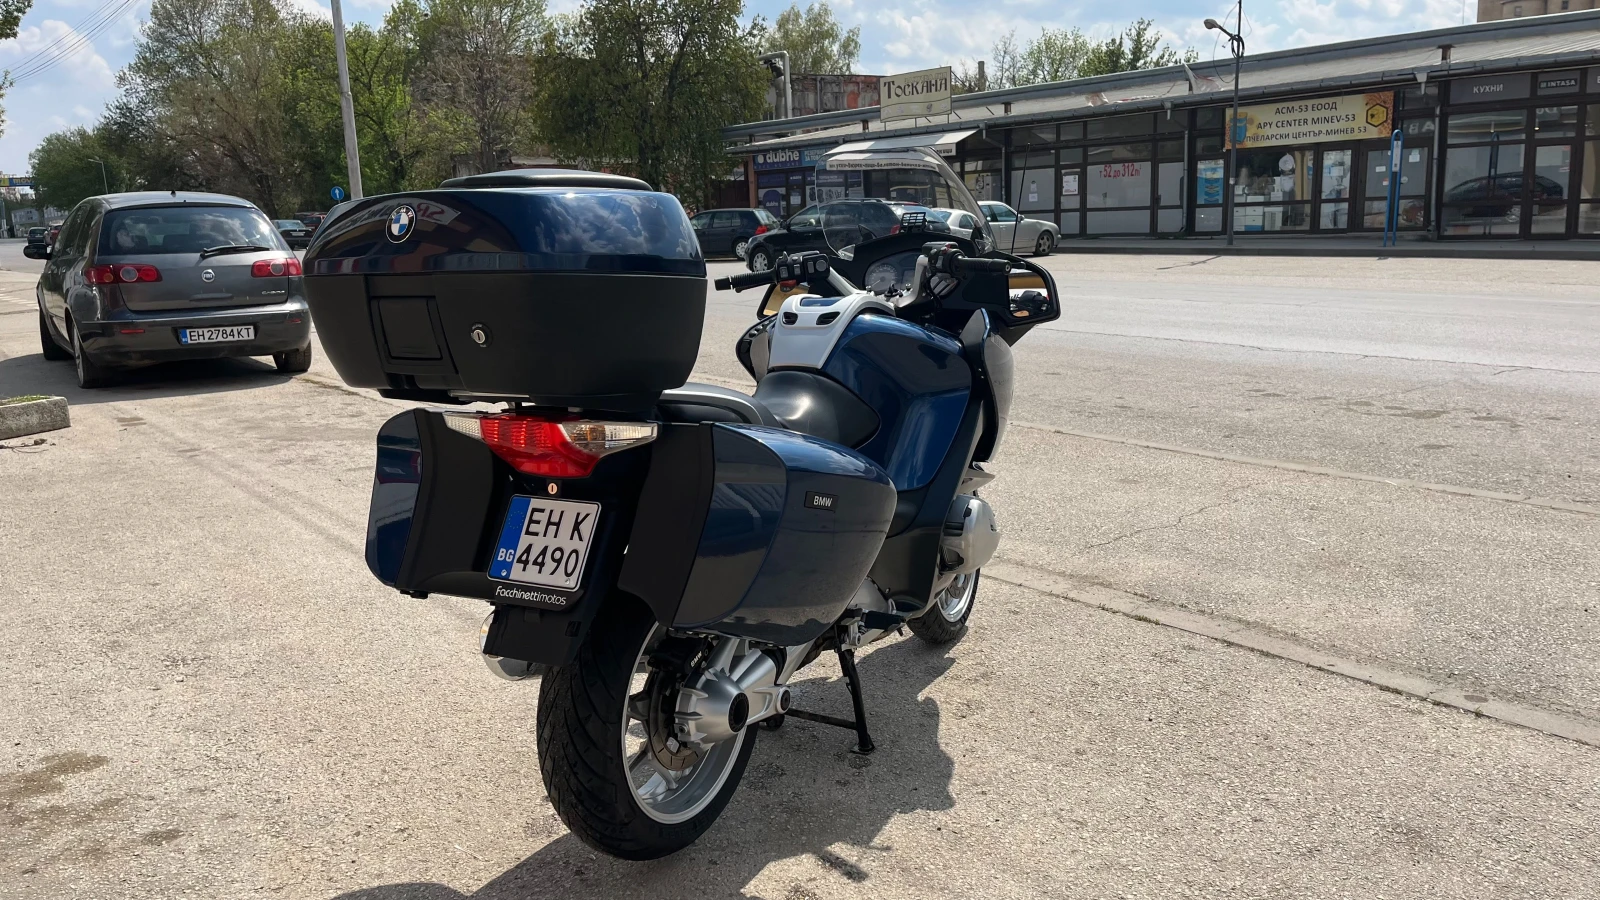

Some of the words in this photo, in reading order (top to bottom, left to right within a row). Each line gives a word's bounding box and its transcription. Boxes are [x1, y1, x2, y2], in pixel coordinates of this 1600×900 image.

[1473, 84, 1503, 94] КУХНИ
[1547, 79, 1576, 87] INTASA
[1274, 104, 1309, 115] АСМ-53
[1311, 101, 1338, 113] ЕООД
[1275, 118, 1309, 129] CENTER
[1311, 113, 1356, 126] MINEV-53
[1357, 126, 1367, 134] 53
[766, 149, 800, 163] dubhe
[1103, 164, 1112, 178] 52
[813, 495, 833, 507] BMW
[524, 507, 565, 539] EH
[569, 511, 591, 542] K
[497, 548, 515, 562] BG
[515, 543, 579, 578] 4490
